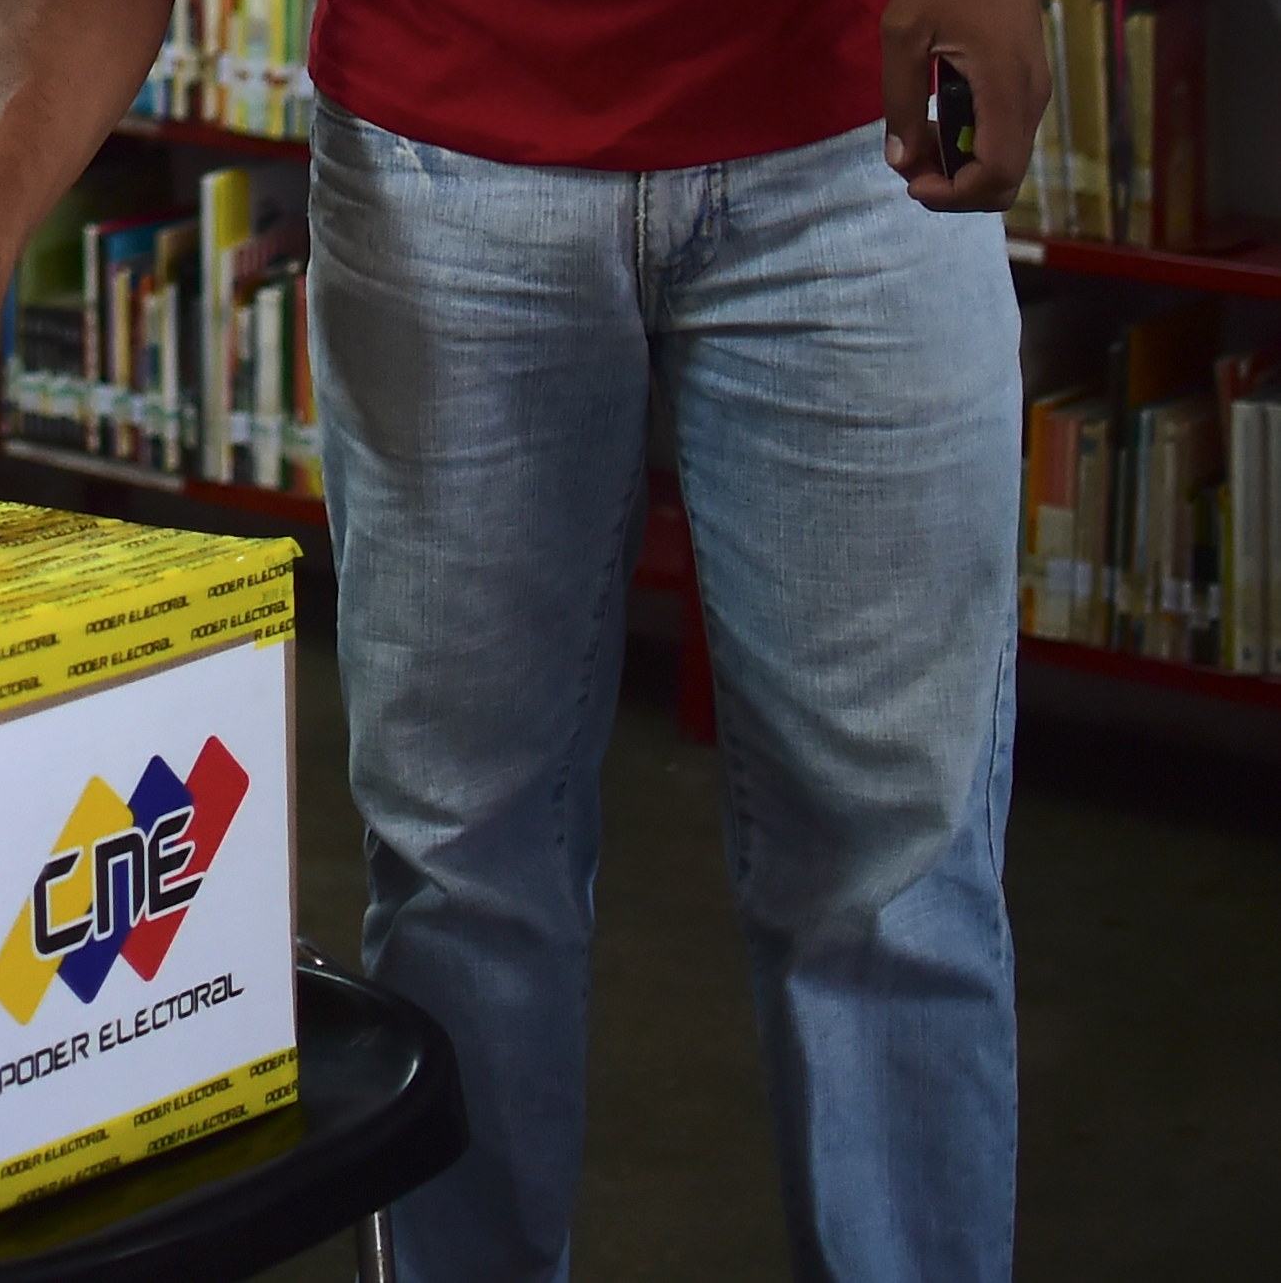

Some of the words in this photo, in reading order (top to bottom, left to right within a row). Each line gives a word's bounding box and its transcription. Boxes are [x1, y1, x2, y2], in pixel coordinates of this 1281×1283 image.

[208, 577, 245, 599] PODER
[85, 613, 126, 636] PODER
[191, 618, 228, 641] PODER
[231, 600, 290, 628] ELECTORAL
[33, 808, 204, 955] CNE
[99, 972, 245, 1053] ELECTORAL
[134, 1102, 172, 1128] PODER
